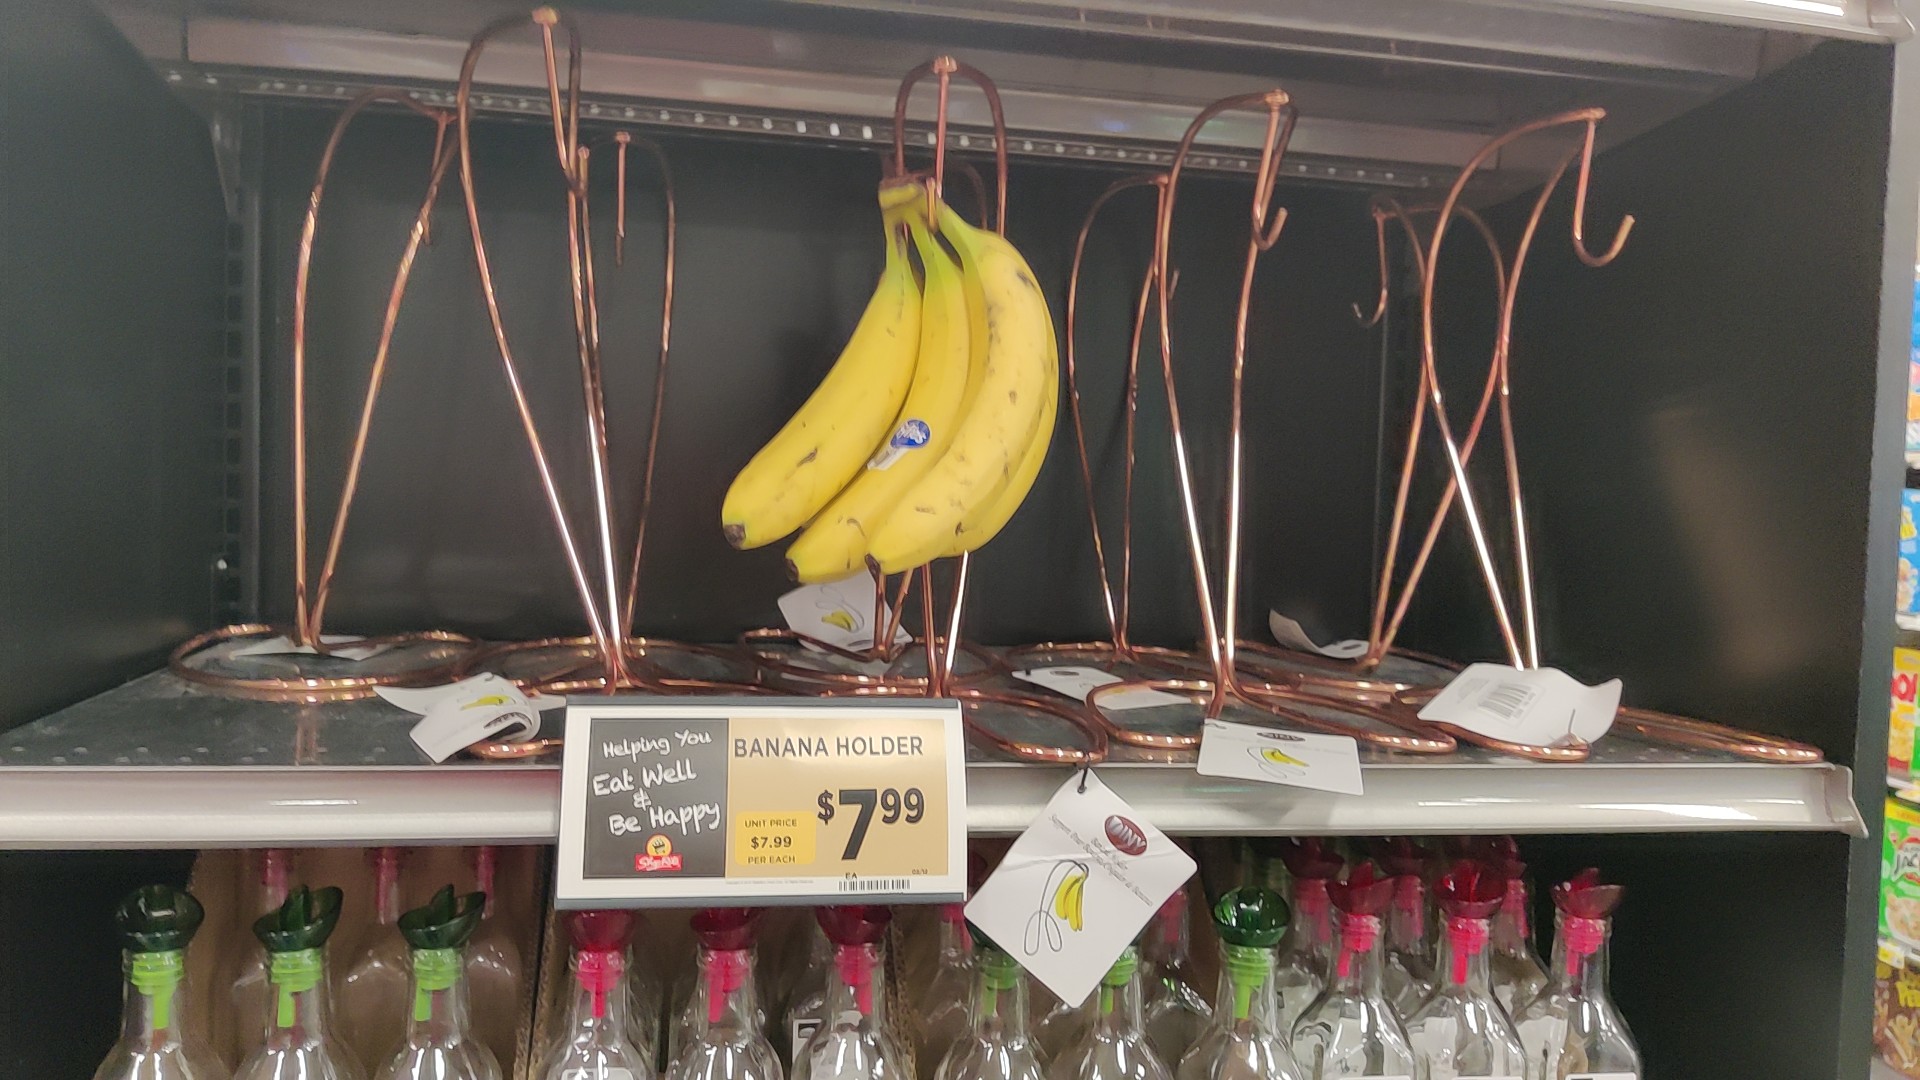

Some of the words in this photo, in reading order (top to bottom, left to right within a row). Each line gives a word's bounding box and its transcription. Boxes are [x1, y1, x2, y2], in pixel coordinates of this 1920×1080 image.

[602, 736, 671, 763] Helping
[674, 729, 713, 747] You
[734, 737, 829, 758] BANANA
[836, 736, 923, 756] HOLDER
[592, 767, 635, 796] Eat
[642, 757, 697, 789] Well
[632, 787, 652, 812] &
[608, 813, 642, 836] Be
[648, 802, 721, 836] Happy
[744, 819, 766, 828] UNIT
[769, 818, 798, 828] PRICE
[750, 836, 793, 849] $7.99
[747, 856, 766, 865] PER
[769, 855, 796, 865] EACH
